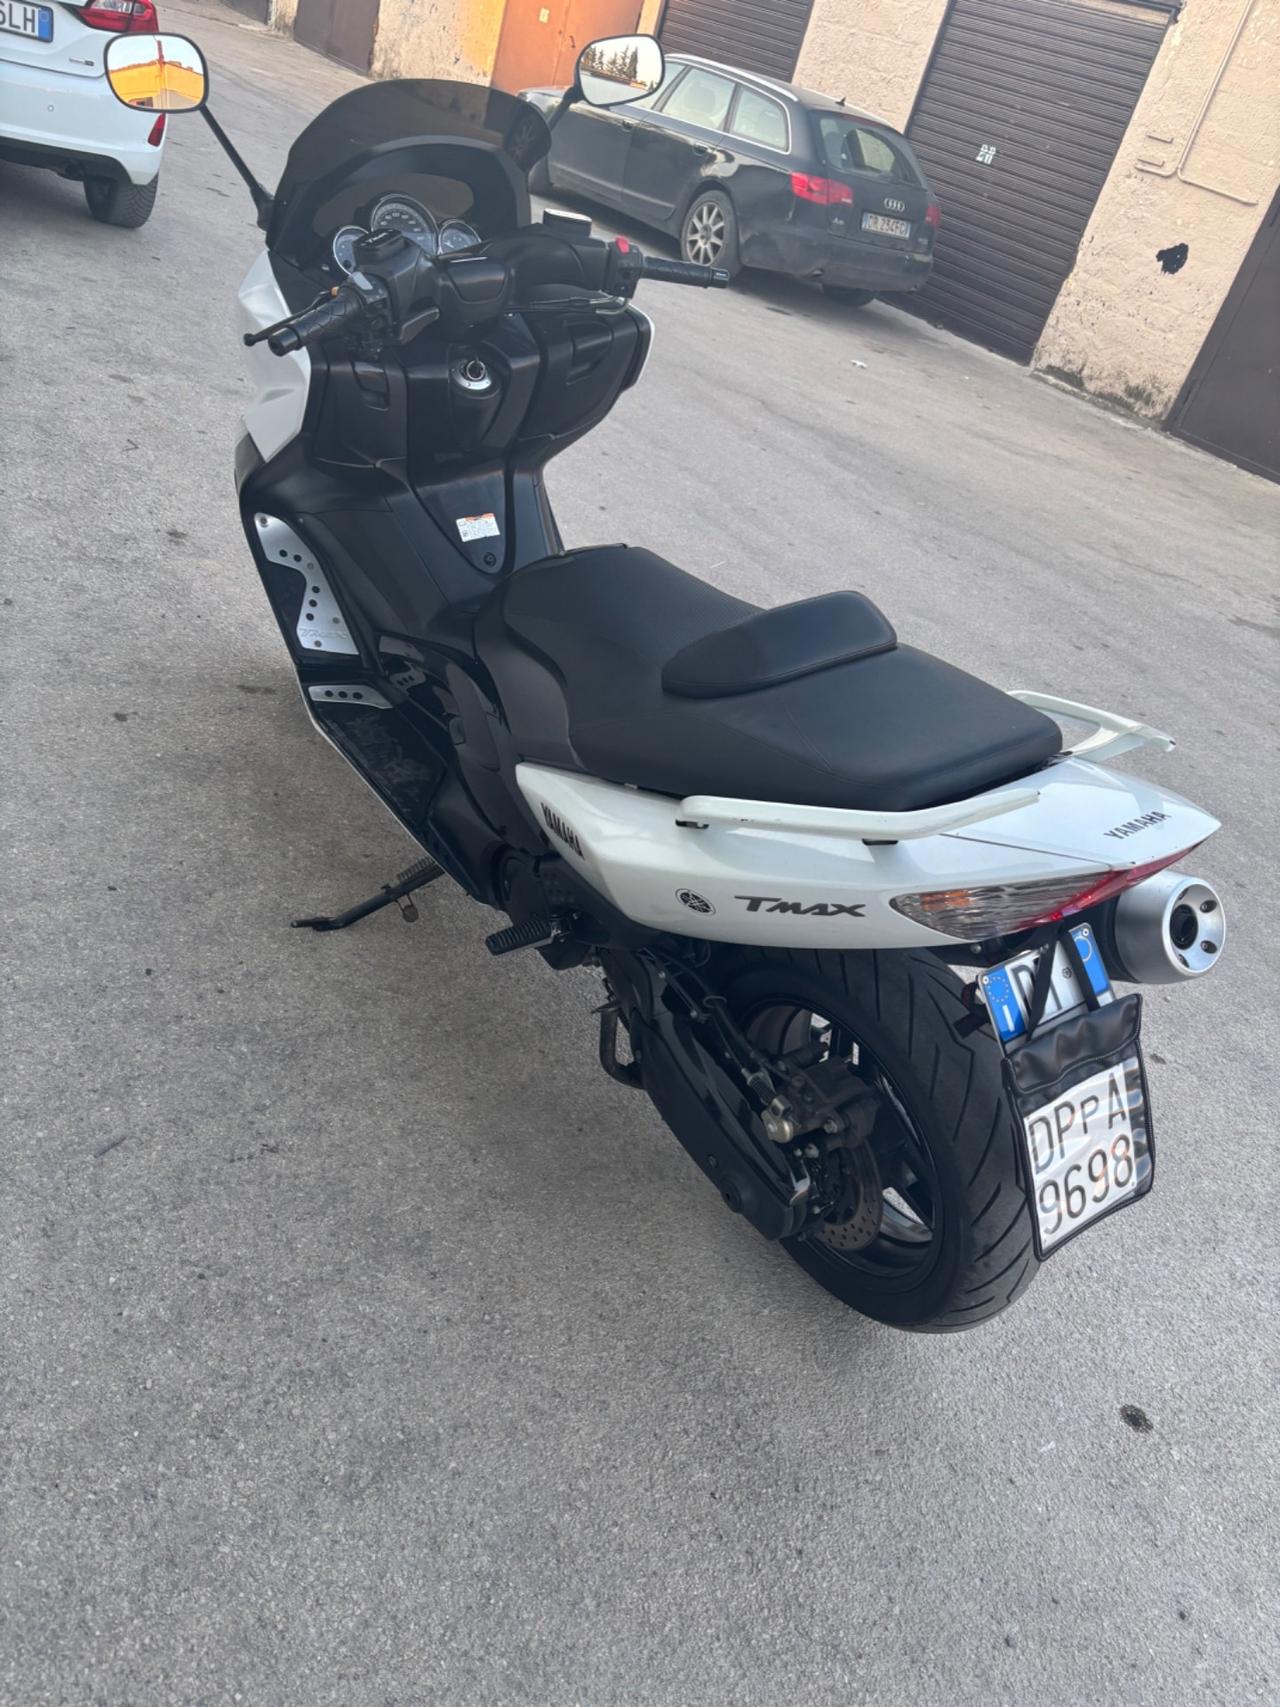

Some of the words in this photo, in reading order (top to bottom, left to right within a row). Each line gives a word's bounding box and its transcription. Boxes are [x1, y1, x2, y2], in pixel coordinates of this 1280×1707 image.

[540, 802, 585, 861] YAMAHA
[1103, 811, 1172, 839] YAMAHA
[1039, 1133, 1133, 1235] 9698
